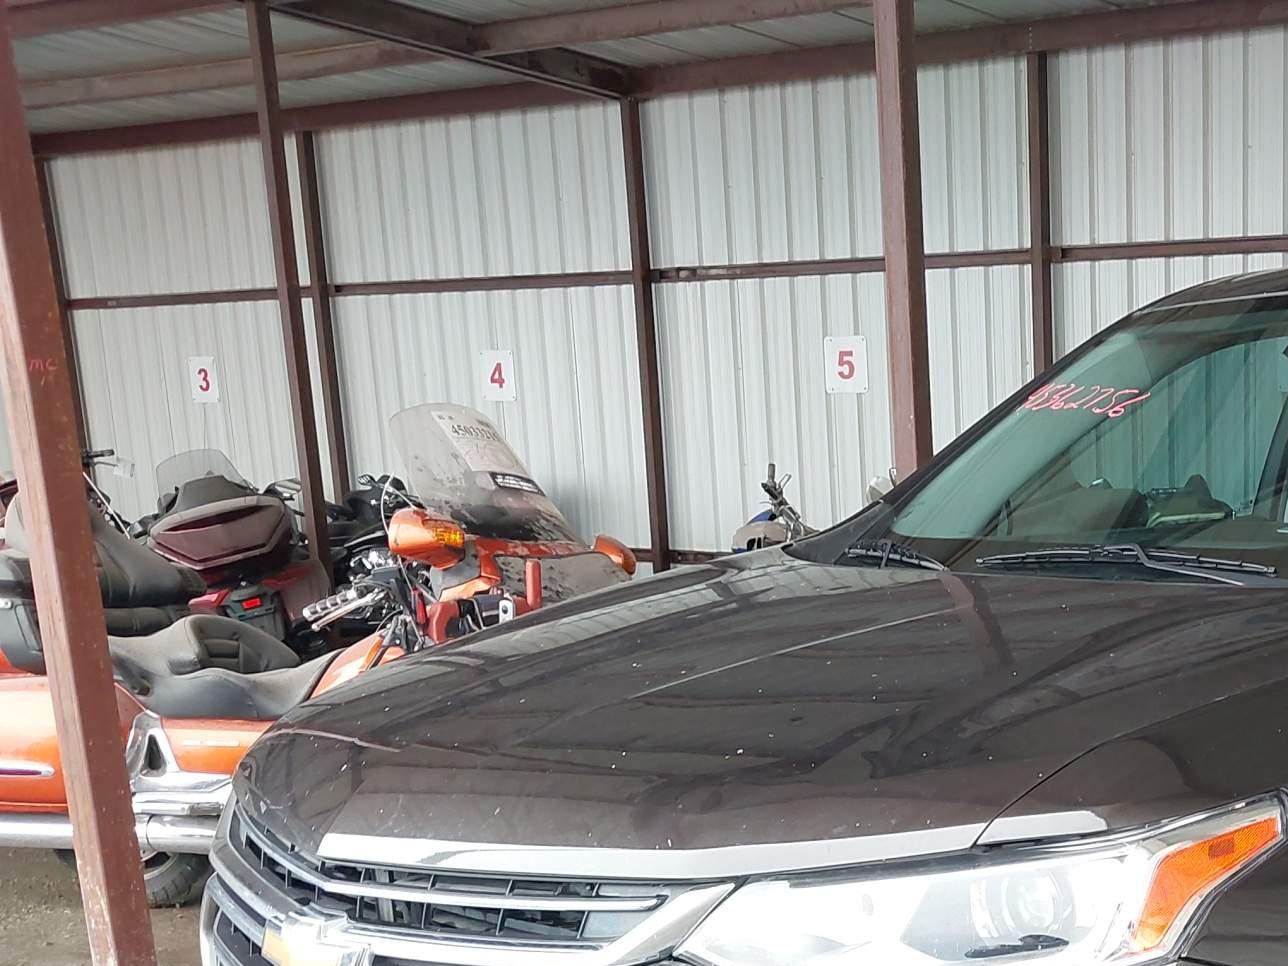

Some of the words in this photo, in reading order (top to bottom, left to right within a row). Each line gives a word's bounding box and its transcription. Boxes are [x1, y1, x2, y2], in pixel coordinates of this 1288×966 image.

[490, 362, 505, 389] 4
[837, 350, 855, 380] 5
[197, 367, 210, 392] 3
